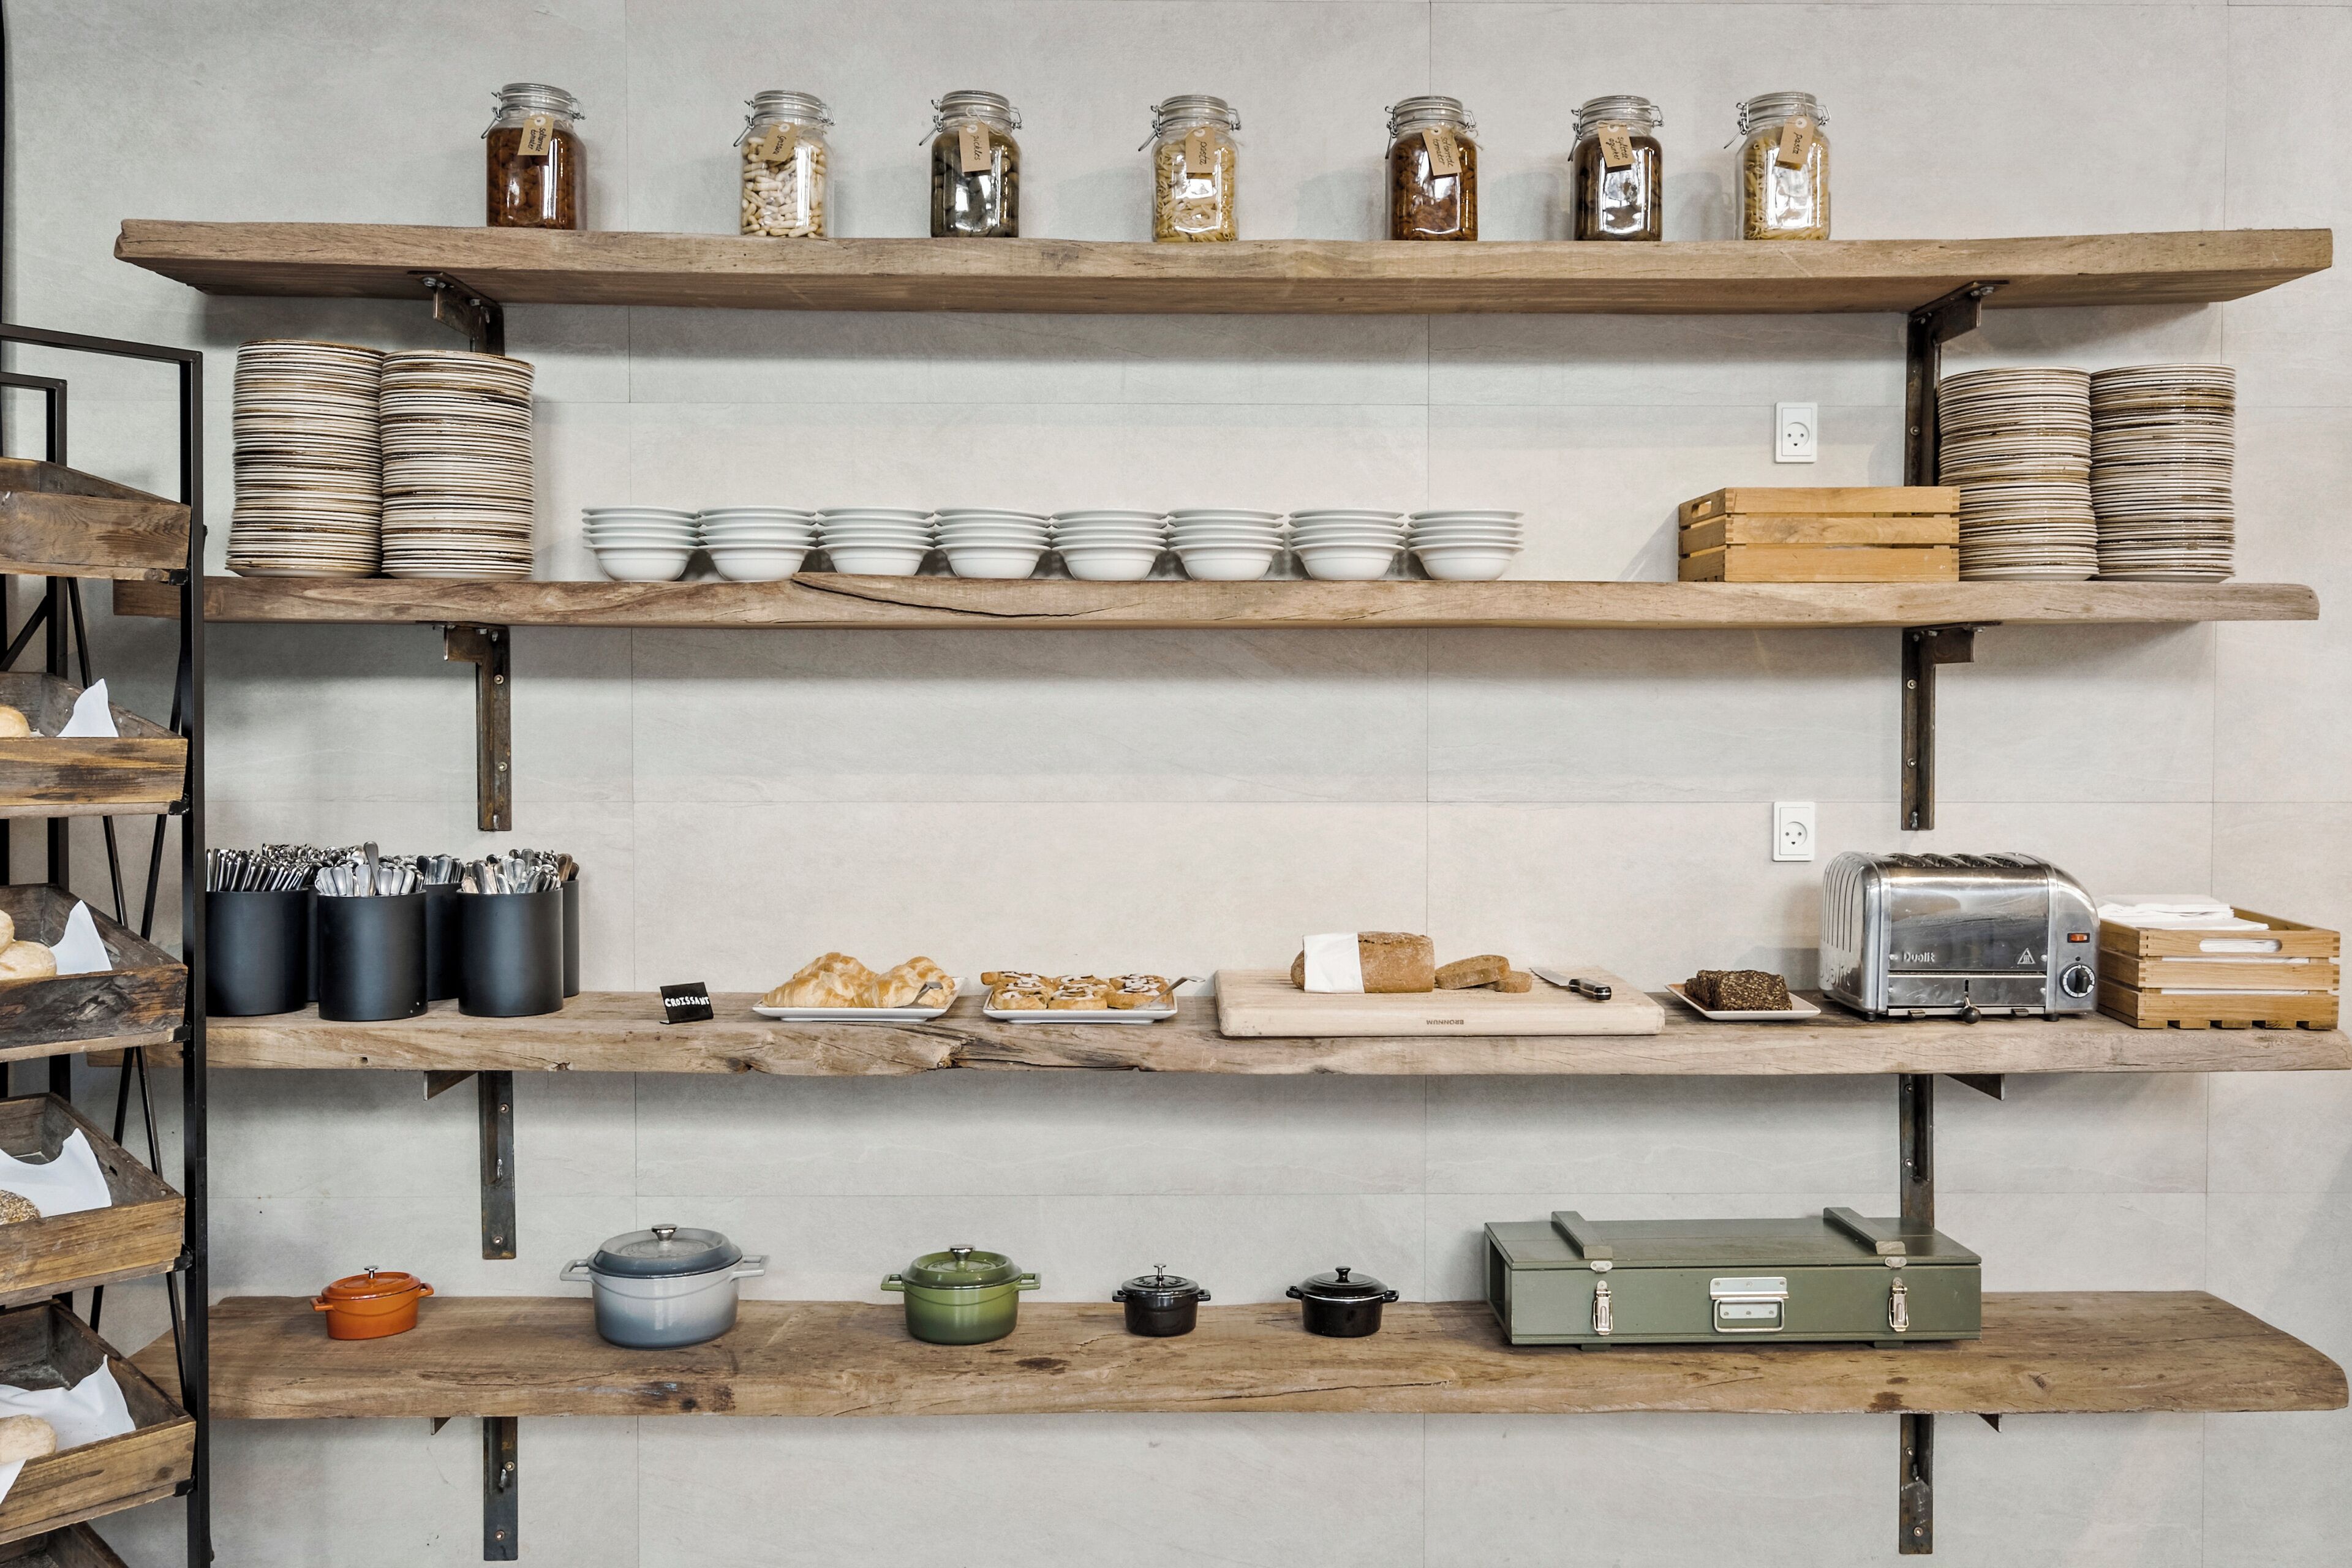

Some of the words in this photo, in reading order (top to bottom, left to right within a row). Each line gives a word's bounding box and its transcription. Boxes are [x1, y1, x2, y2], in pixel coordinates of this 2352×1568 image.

[970, 135, 981, 160] pickles
[1199, 139, 1207, 165] pasta
[1792, 132, 1803, 155] pasta
[1902, 951, 1936, 962] Dualit
[664, 996, 710, 1008] CROISSANT
